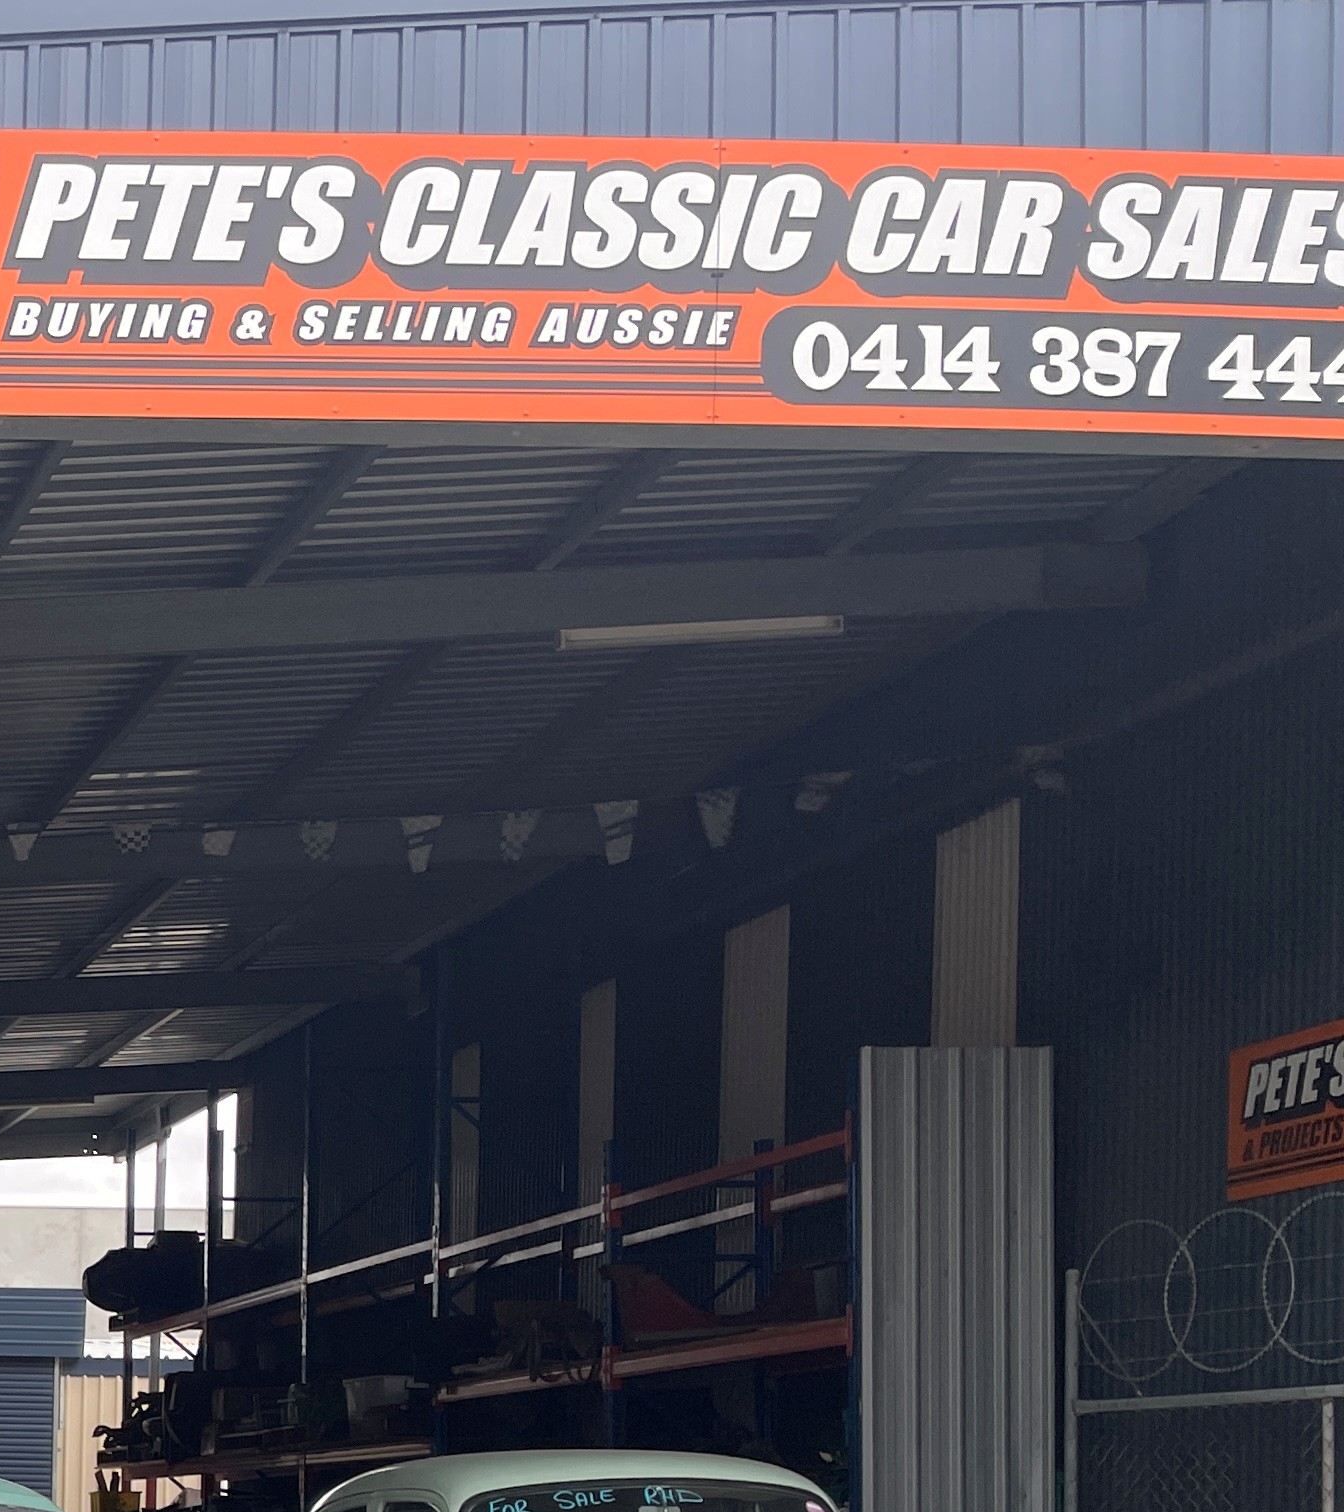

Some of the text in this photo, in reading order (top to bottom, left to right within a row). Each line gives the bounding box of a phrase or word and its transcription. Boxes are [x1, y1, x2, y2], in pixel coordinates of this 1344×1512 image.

[12, 160, 357, 264] PETE'S
[378, 165, 824, 272] CLASSIC
[846, 173, 1064, 276] CAR
[9, 300, 734, 347] BUYING & SELLING AUSSIE
[792, 320, 1001, 393] 0414
[1029, 326, 1181, 397] 387
[1244, 1040, 1344, 1119] PETE'S
[552, 1488, 617, 1510] SALE
[644, 1485, 705, 1505] RHD
